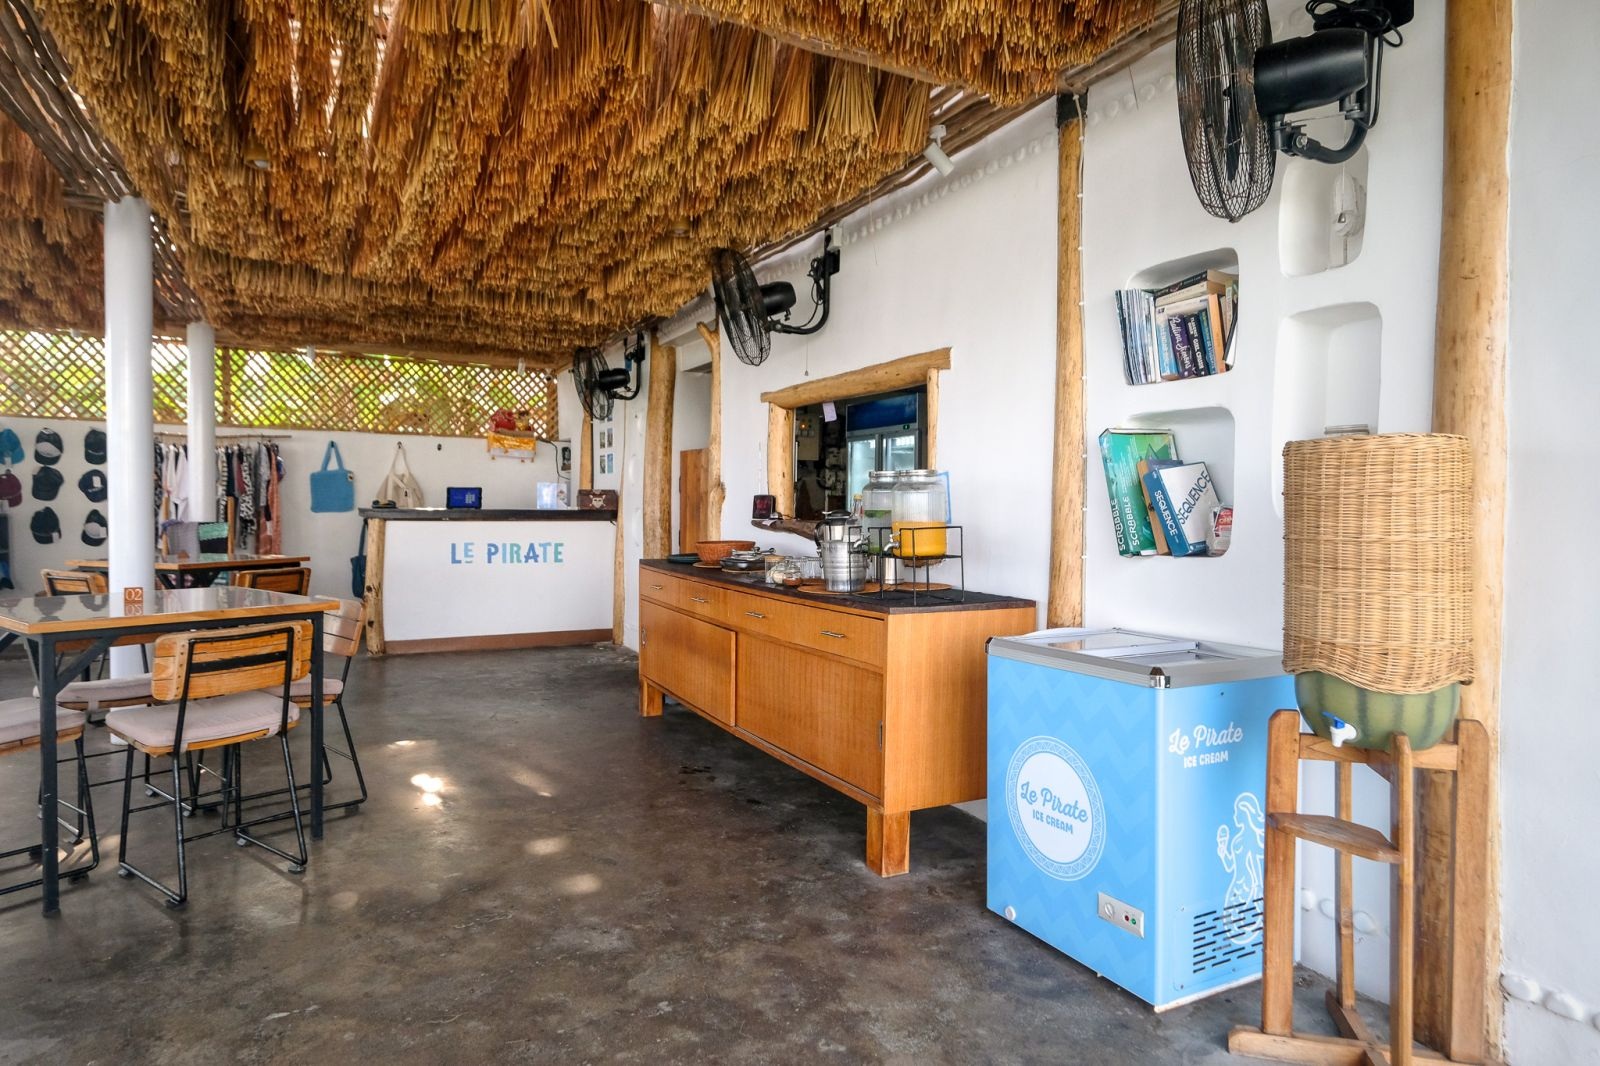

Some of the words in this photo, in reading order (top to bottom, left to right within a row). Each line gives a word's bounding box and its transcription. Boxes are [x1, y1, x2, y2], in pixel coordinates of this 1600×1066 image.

[1155, 490, 1178, 536] SEQUENCE
[1178, 470, 1211, 525] SEQUENCE
[1111, 498, 1126, 551] SCRABBLE
[1123, 496, 1140, 546] SCRABBLE
[451, 542, 475, 564] LE
[487, 542, 564, 564] PIRATE
[126, 588, 142, 601] 02
[1168, 728, 1190, 755] Le
[1193, 721, 1243, 749] Pirate
[1183, 755, 1197, 769] ICE
[1199, 750, 1229, 766] CREAM
[1021, 781, 1038, 805] Le
[1041, 787, 1088, 823] Pirate
[1032, 809, 1045, 823] ICE
[1046, 814, 1074, 835] CREAM
